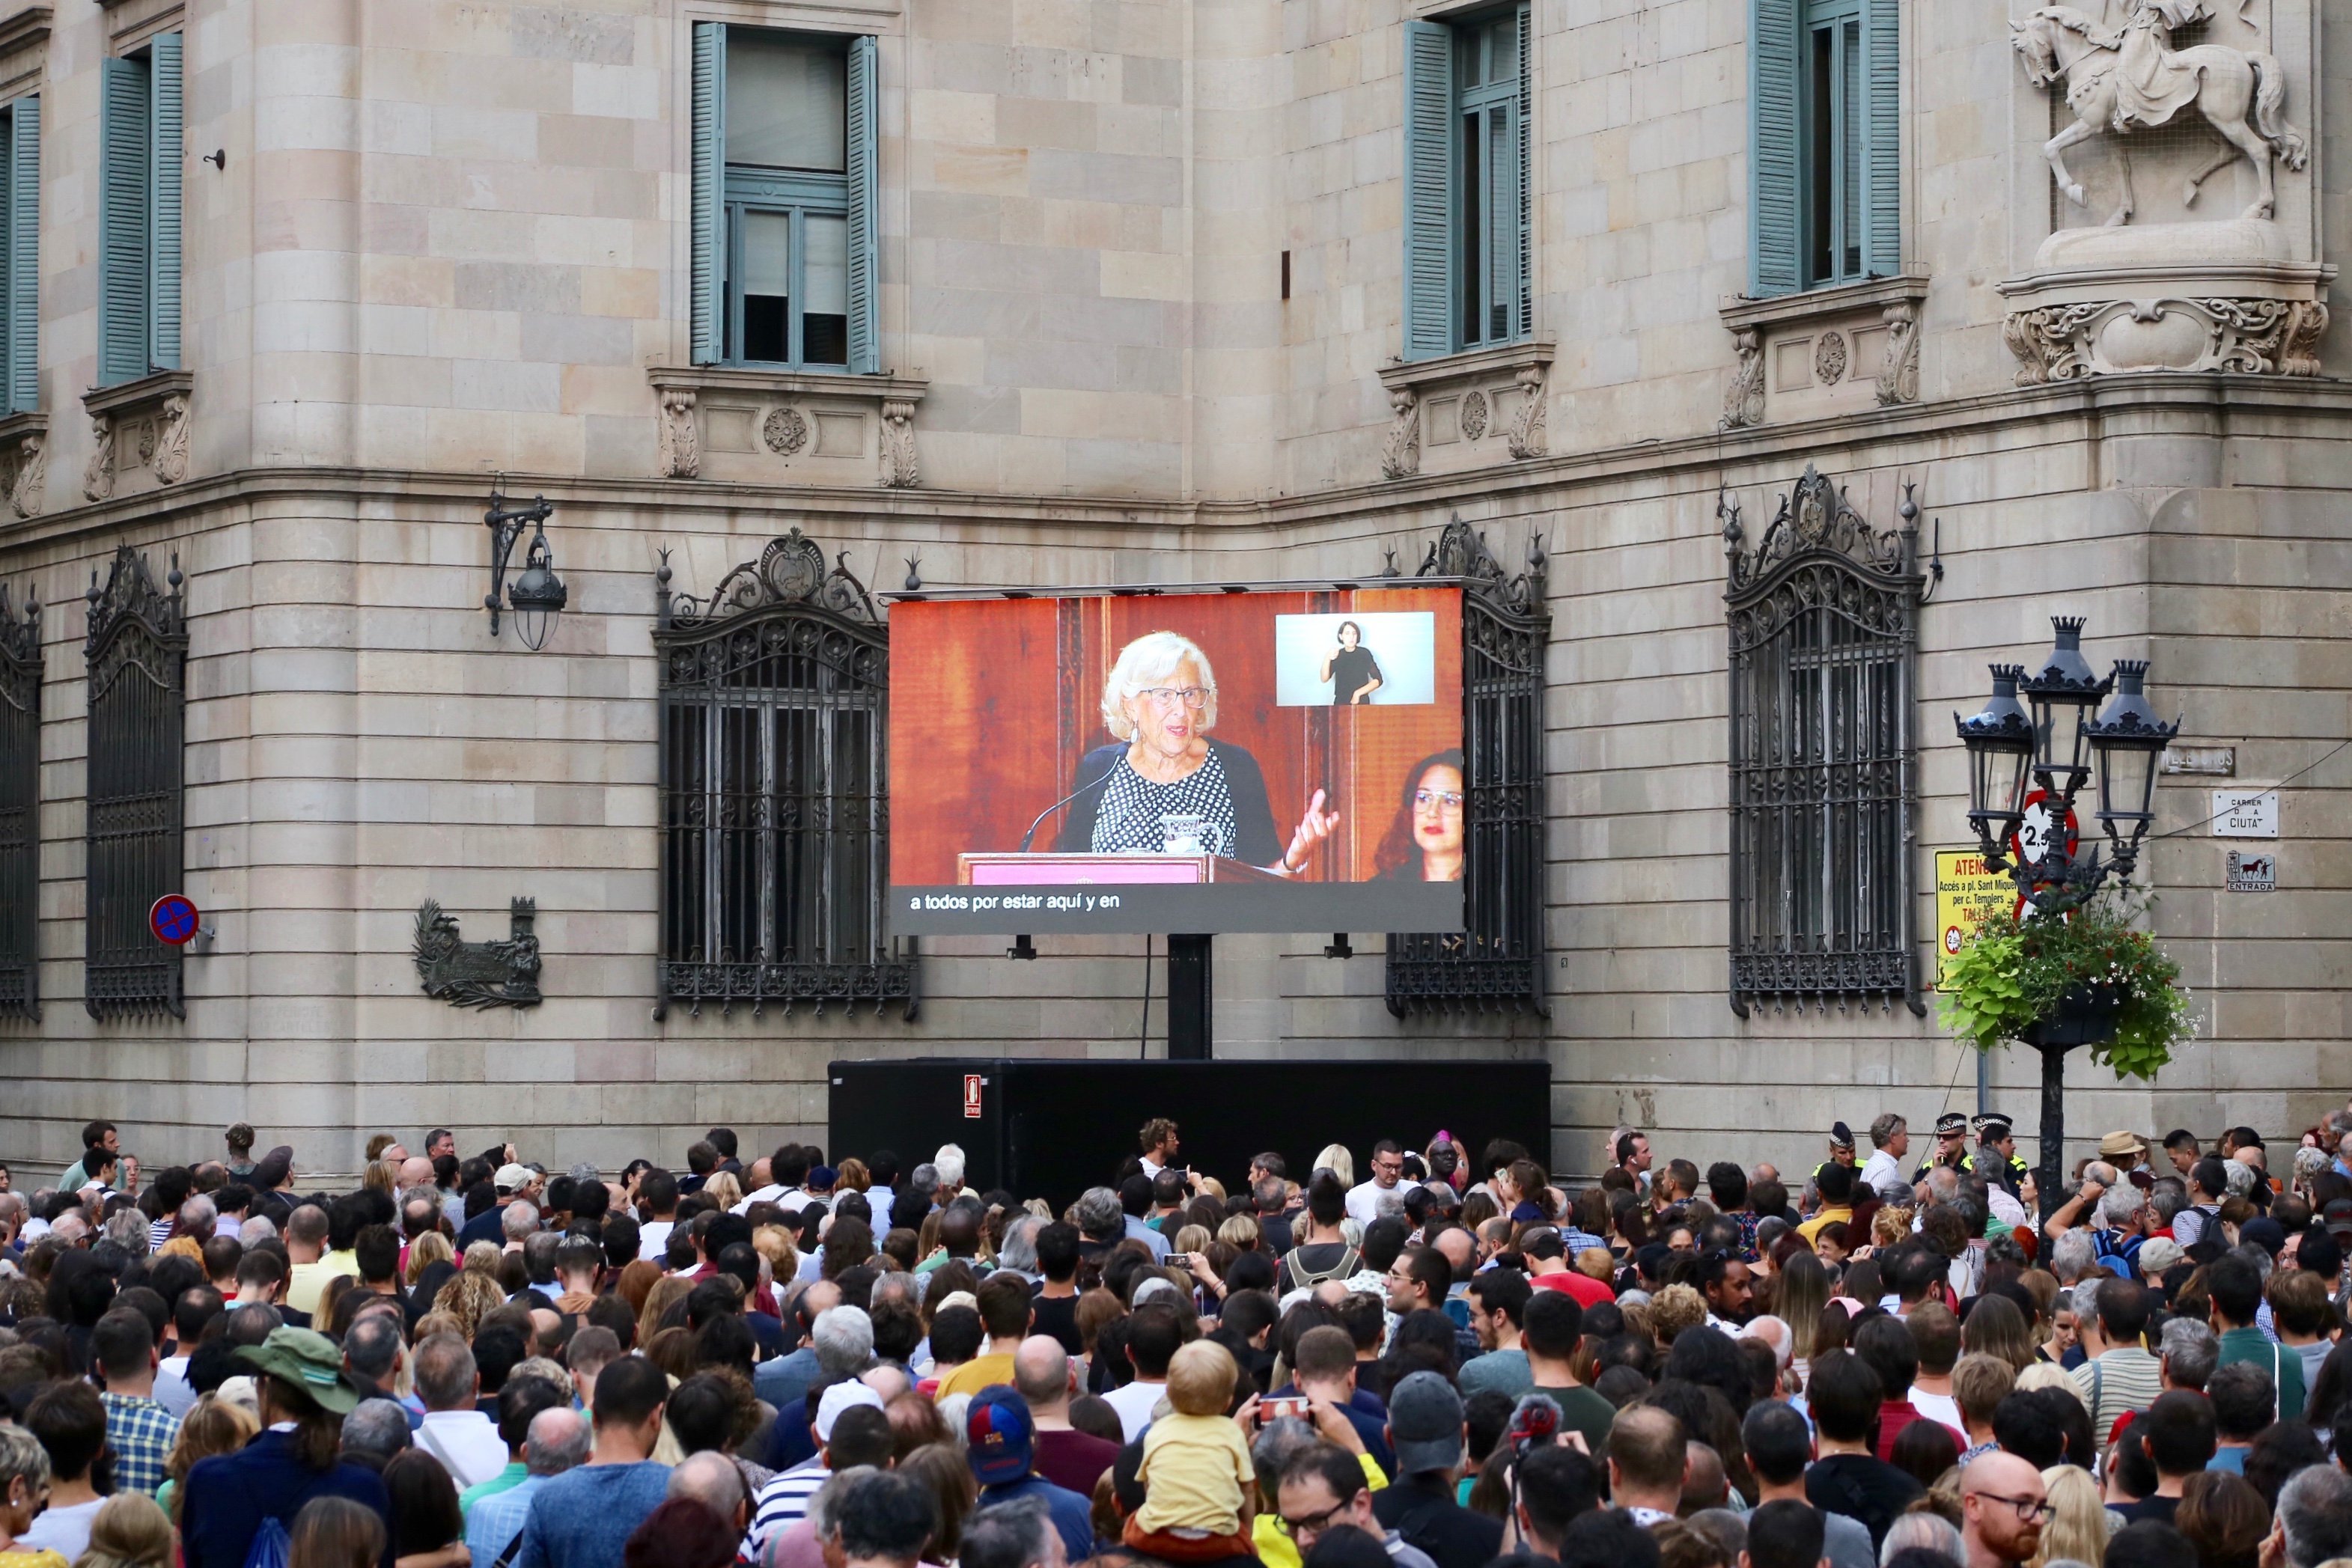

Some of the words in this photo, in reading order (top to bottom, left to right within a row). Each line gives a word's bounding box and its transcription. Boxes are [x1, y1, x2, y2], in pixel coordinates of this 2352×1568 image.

[1939, 881, 1960, 891] Accés
[1967, 880, 1975, 893] pl.
[1978, 879, 1993, 891] Sant
[910, 897, 921, 909] a
[925, 894, 969, 909] todos
[972, 896, 999, 912] por
[1002, 894, 1043, 909] estar
[1046, 893, 1082, 912] aquí
[1085, 895, 1095, 912] y
[1099, 895, 1120, 908] en
[1952, 896, 1963, 906] per
[1974, 894, 2004, 905] Templers
